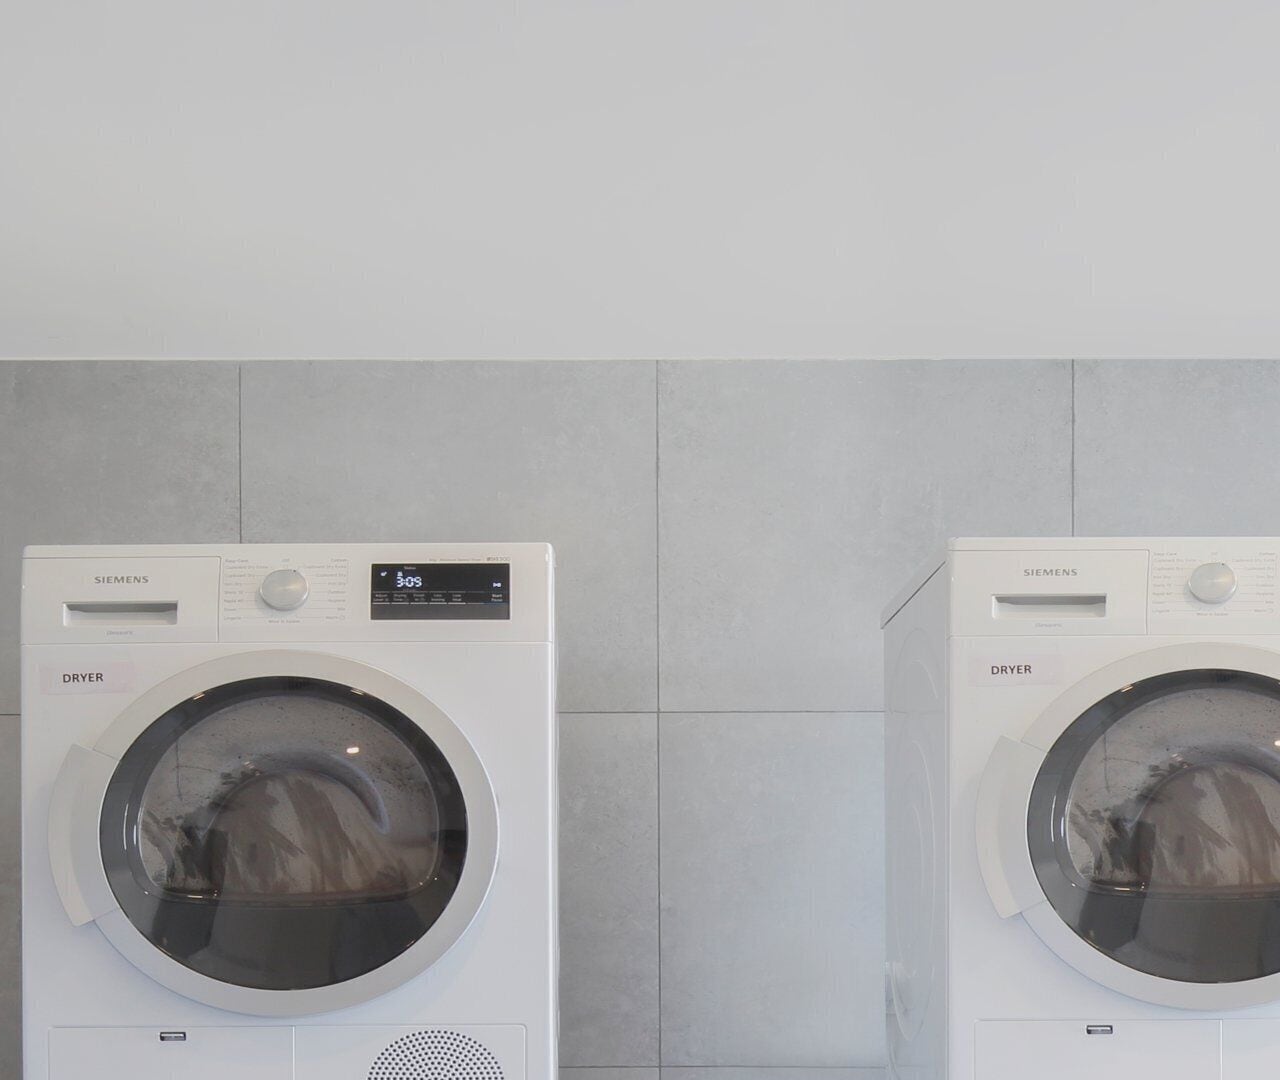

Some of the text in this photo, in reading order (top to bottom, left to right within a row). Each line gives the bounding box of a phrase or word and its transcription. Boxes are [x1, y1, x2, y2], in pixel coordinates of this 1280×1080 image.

[1023, 568, 1078, 577] SIEMENS
[94, 575, 149, 584] SIEMENS
[396, 576, 423, 587] 3:09
[991, 664, 1032, 675] DRYER
[62, 672, 104, 683] DRYER
